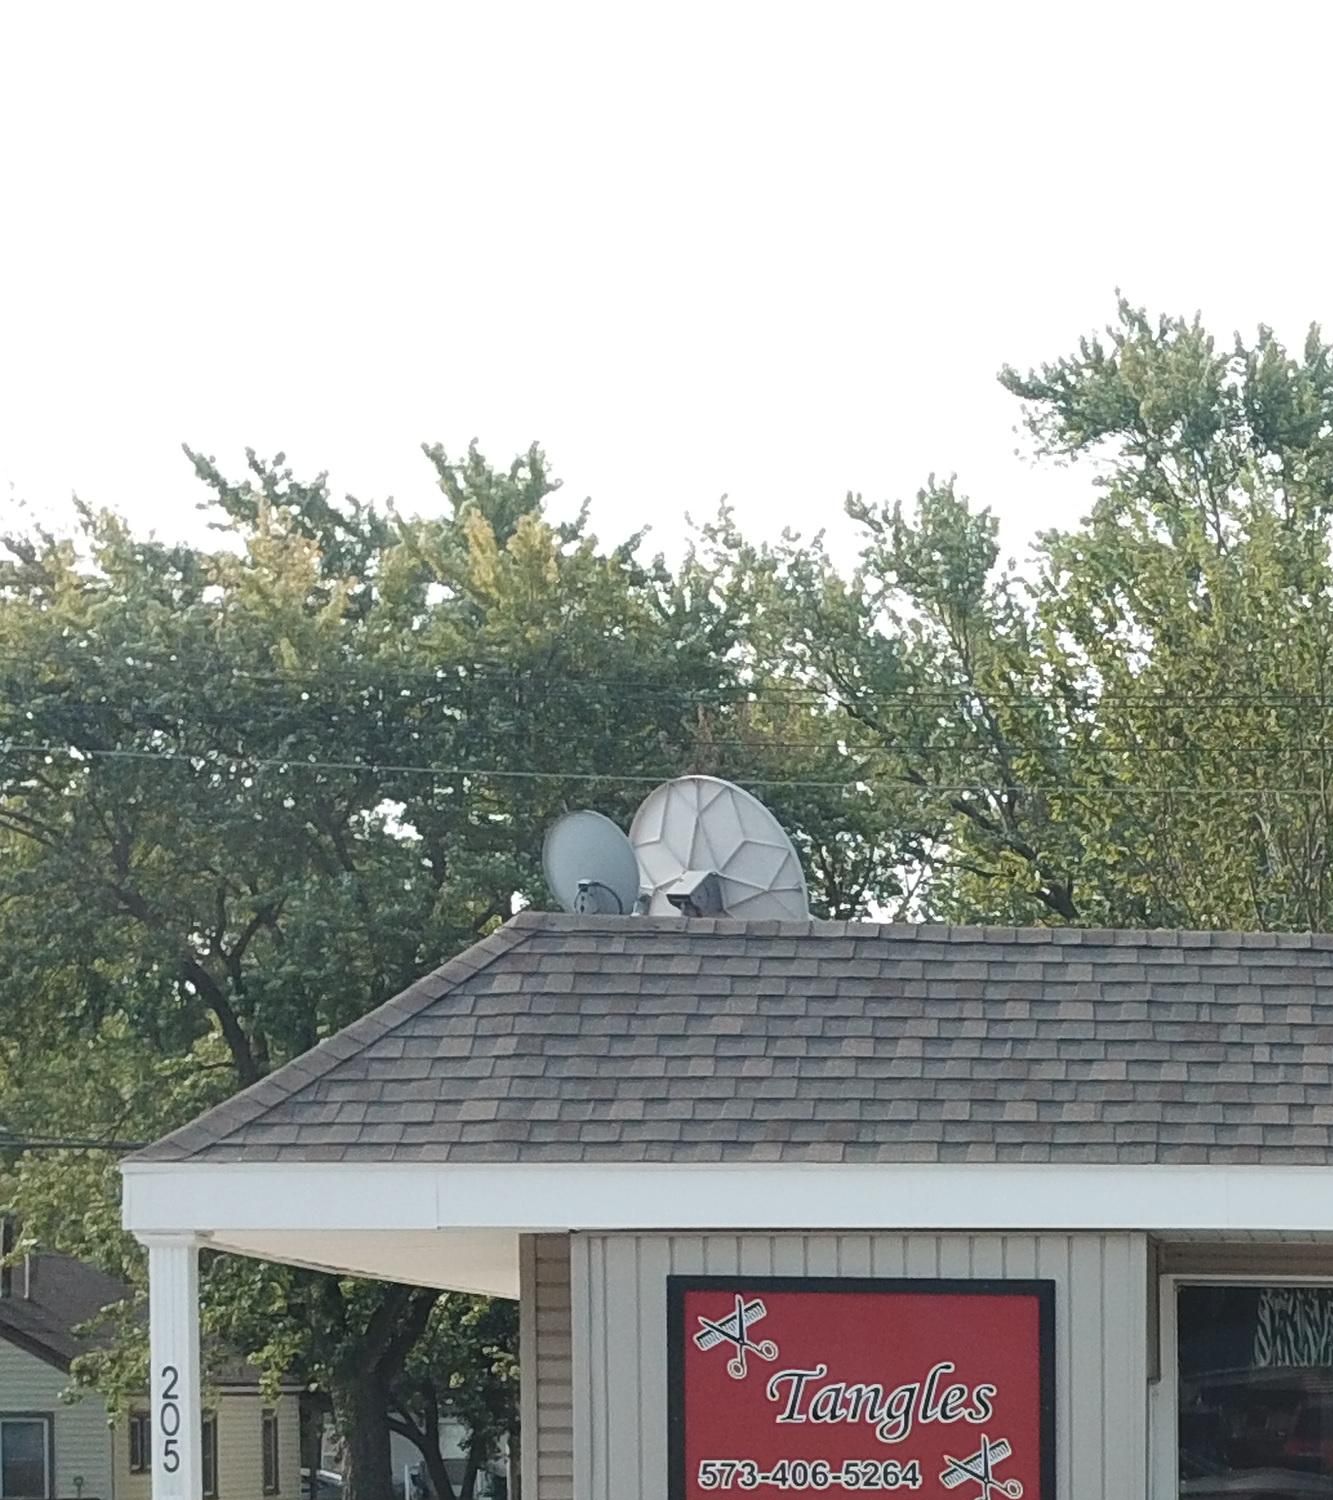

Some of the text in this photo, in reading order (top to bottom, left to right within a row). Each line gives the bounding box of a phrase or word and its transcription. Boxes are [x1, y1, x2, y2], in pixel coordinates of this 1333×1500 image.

[161, 1366, 180, 1473] 205
[767, 1362, 997, 1443] Tangles
[698, 1460, 922, 1489] 573-406-5264
